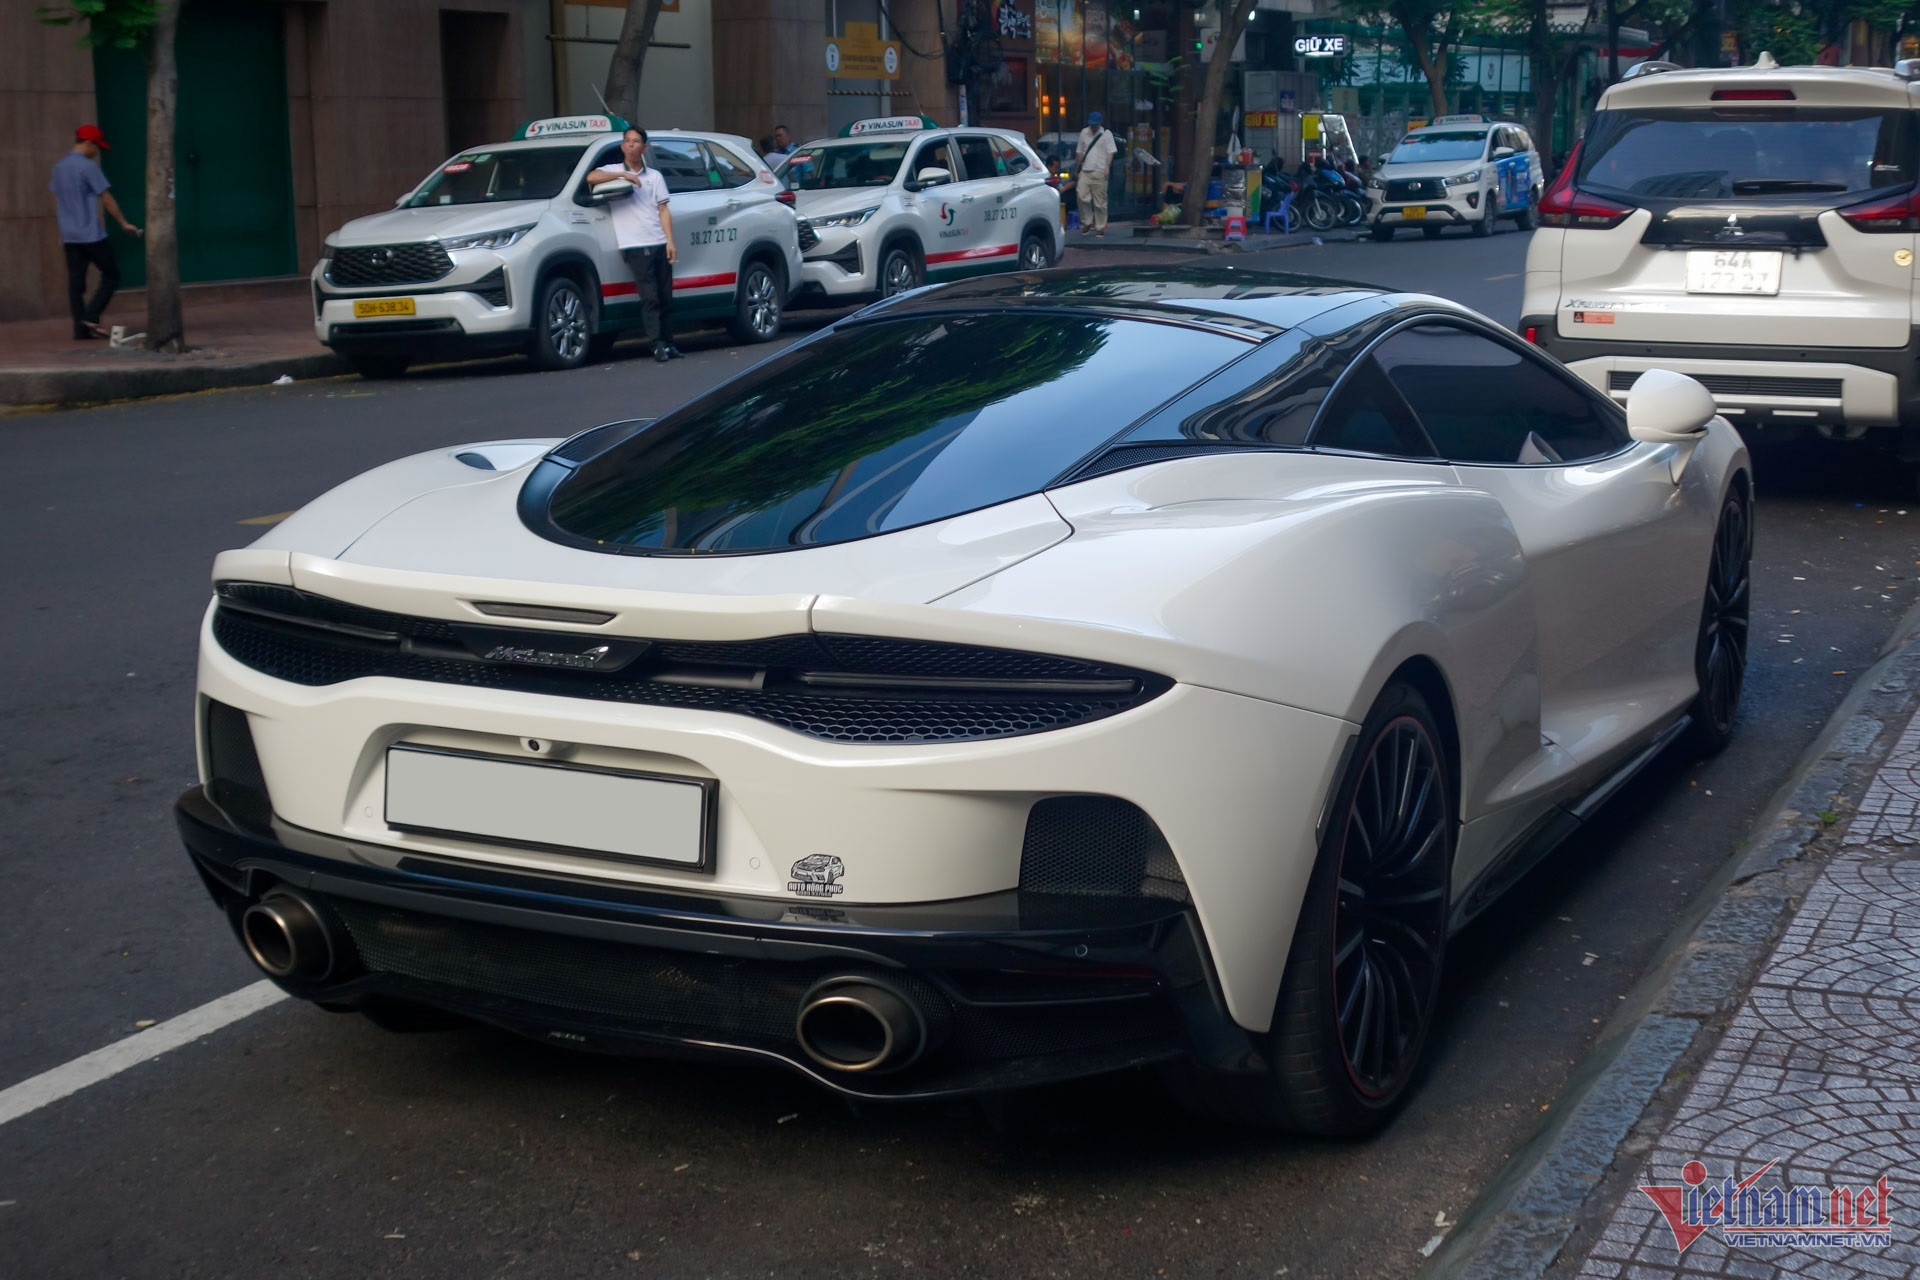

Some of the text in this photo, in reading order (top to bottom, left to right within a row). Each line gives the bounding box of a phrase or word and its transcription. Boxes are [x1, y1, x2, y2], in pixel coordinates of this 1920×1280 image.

[1324, 38, 1344, 51] XE
[545, 119, 607, 132] VINASUN TAXI
[868, 119, 920, 130] VINASUN TAXI
[714, 229, 725, 243] 27
[727, 227, 737, 241] 27
[788, 883, 805, 891] AUTO
